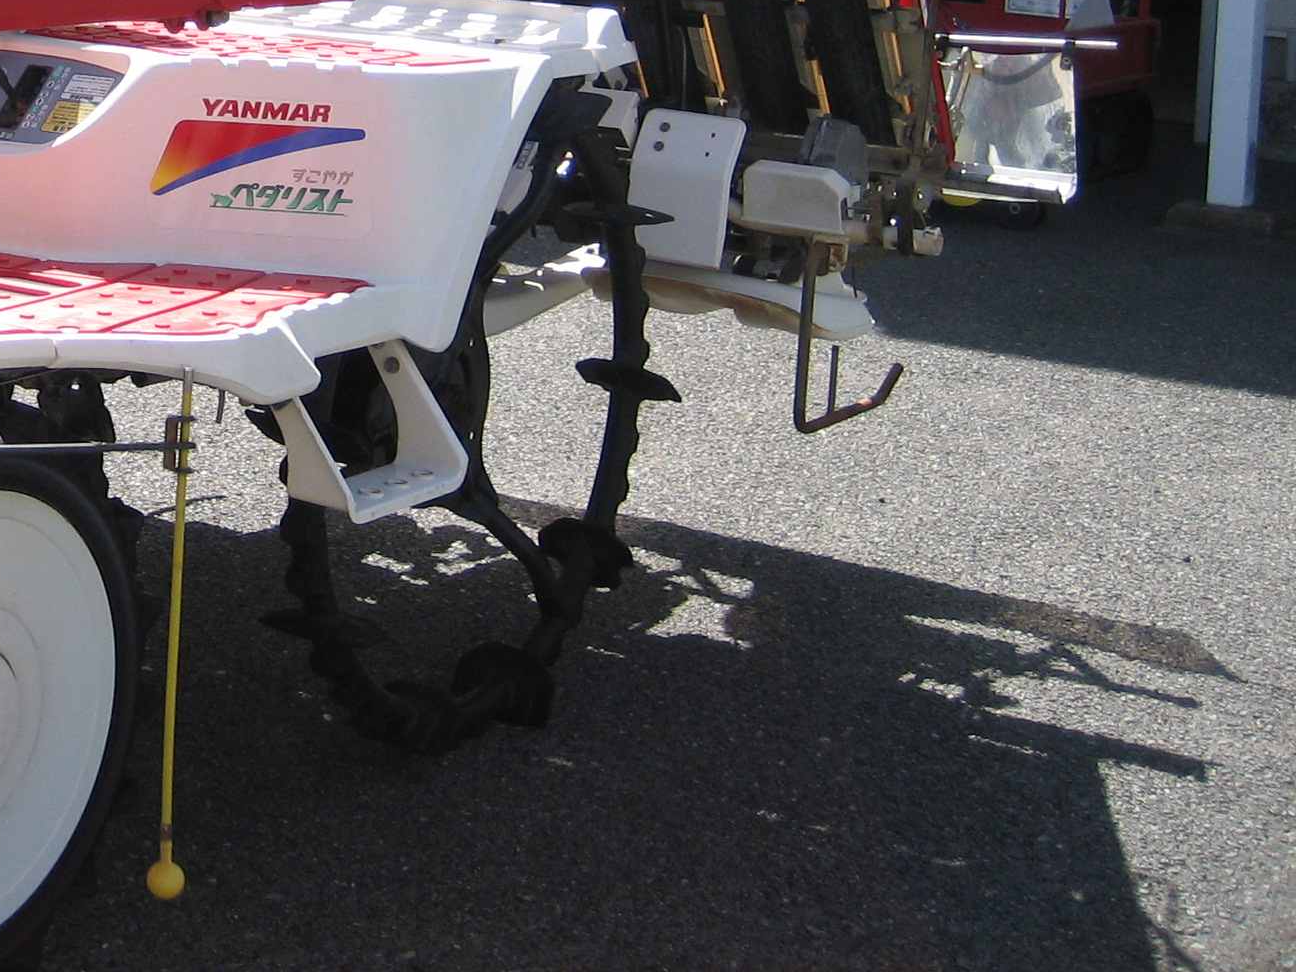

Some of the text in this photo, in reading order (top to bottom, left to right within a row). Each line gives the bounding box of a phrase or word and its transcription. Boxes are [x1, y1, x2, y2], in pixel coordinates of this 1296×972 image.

[202, 98, 331, 123] YANMAR
[232, 183, 353, 212] ペダリスト
